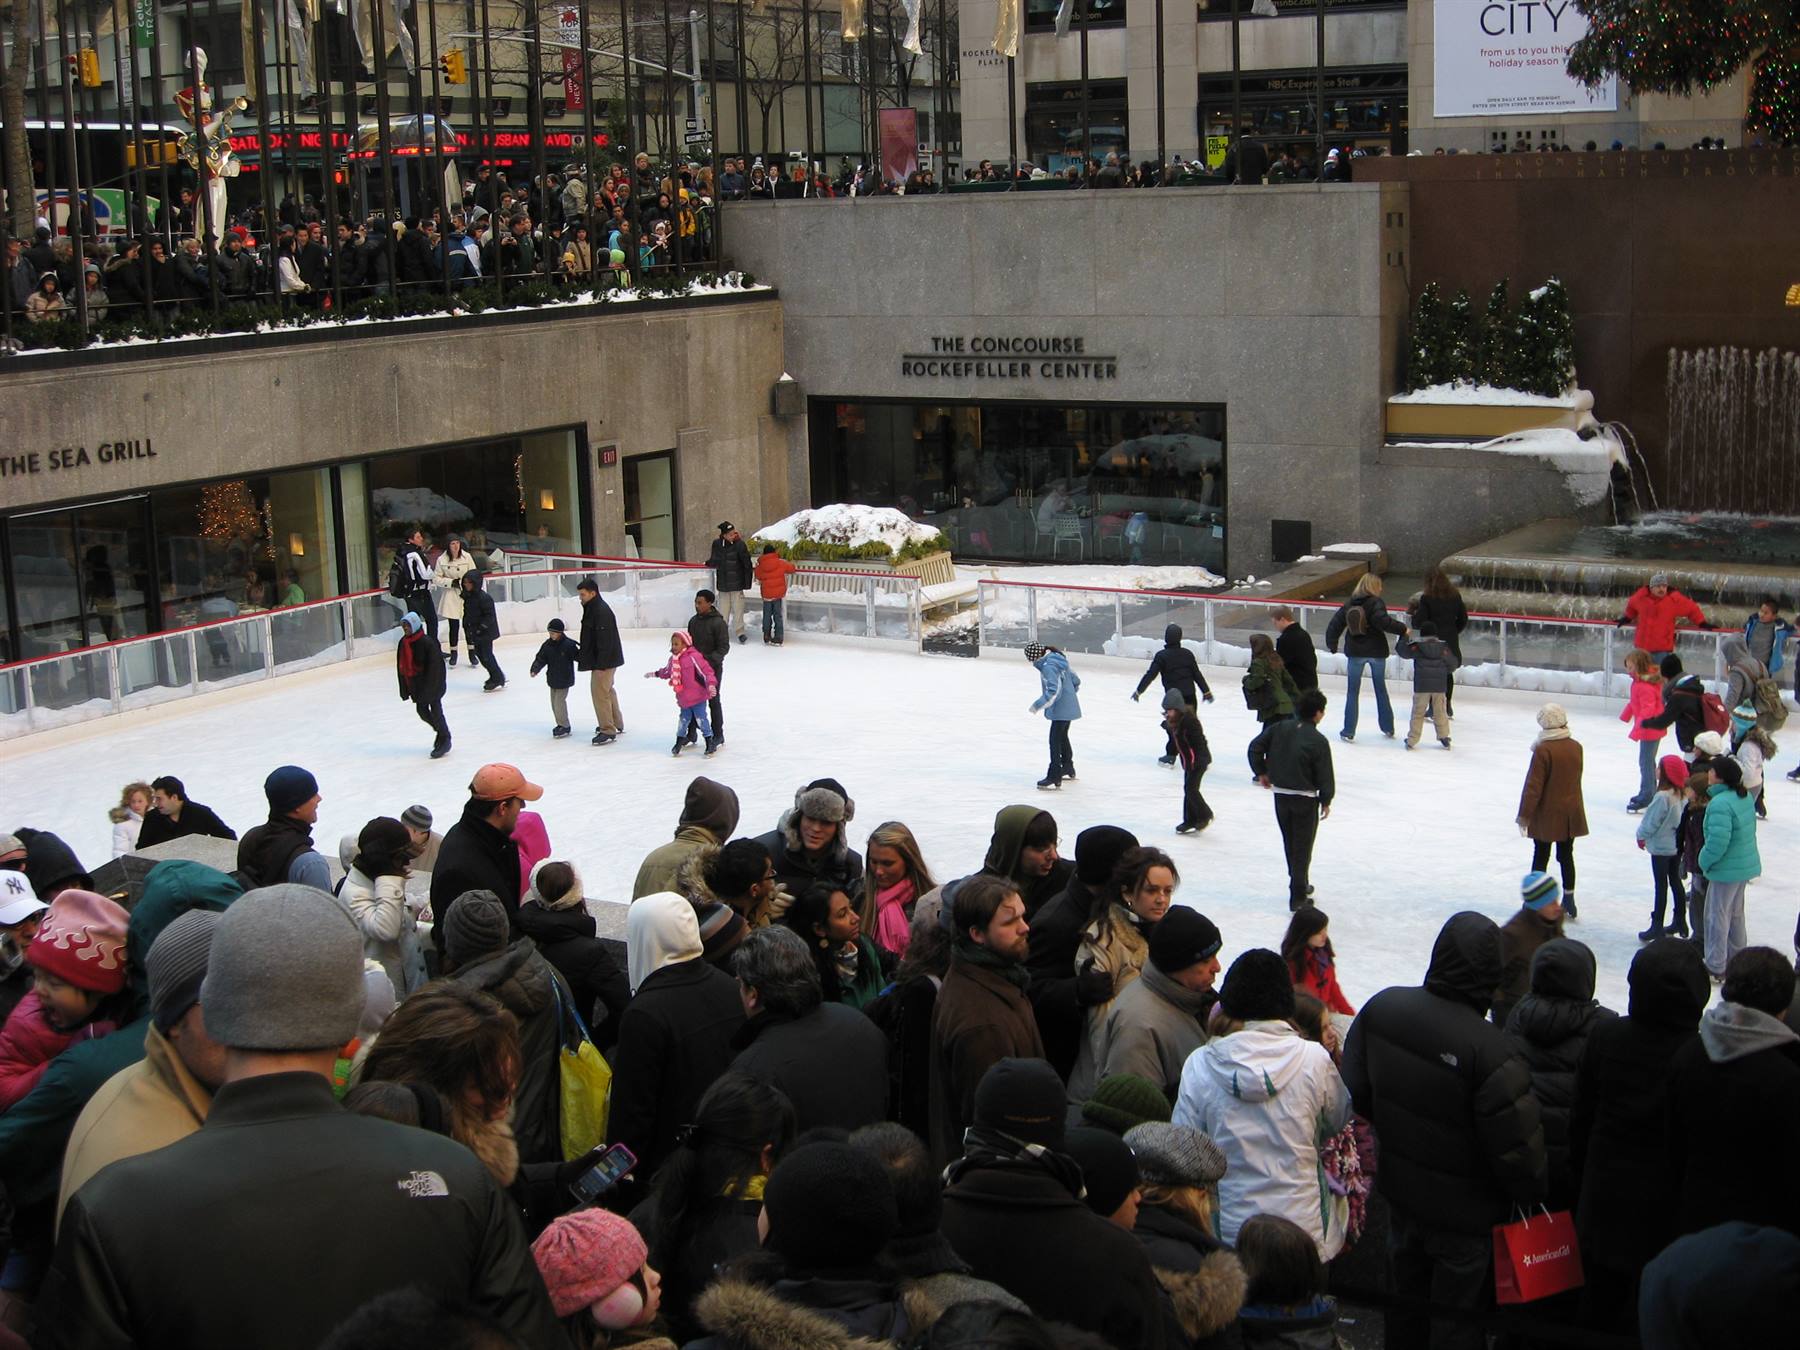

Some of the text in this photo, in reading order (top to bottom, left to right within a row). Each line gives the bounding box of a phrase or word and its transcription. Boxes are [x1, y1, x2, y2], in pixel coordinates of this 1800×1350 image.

[1480, 1, 1568, 36] CITY
[1480, 48, 1503, 57] from
[1518, 47, 1528, 55] to
[1531, 47, 1548, 56] you
[1551, 45, 1568, 54] this
[1489, 58, 1559, 68] holiday season
[1267, 80, 1287, 89] NBC
[300, 132, 339, 148] NIGT
[544, 133, 572, 147] AVID
[931, 336, 1084, 353] THE CONCOURSE
[901, 361, 1117, 379] ROCKEFELLER CENTER
[0, 438, 158, 477] THE SEA GRILL
[409, 1170, 431, 1181] THE
[397, 1179, 431, 1190] NORTH
[410, 1187, 433, 1197] FACE
